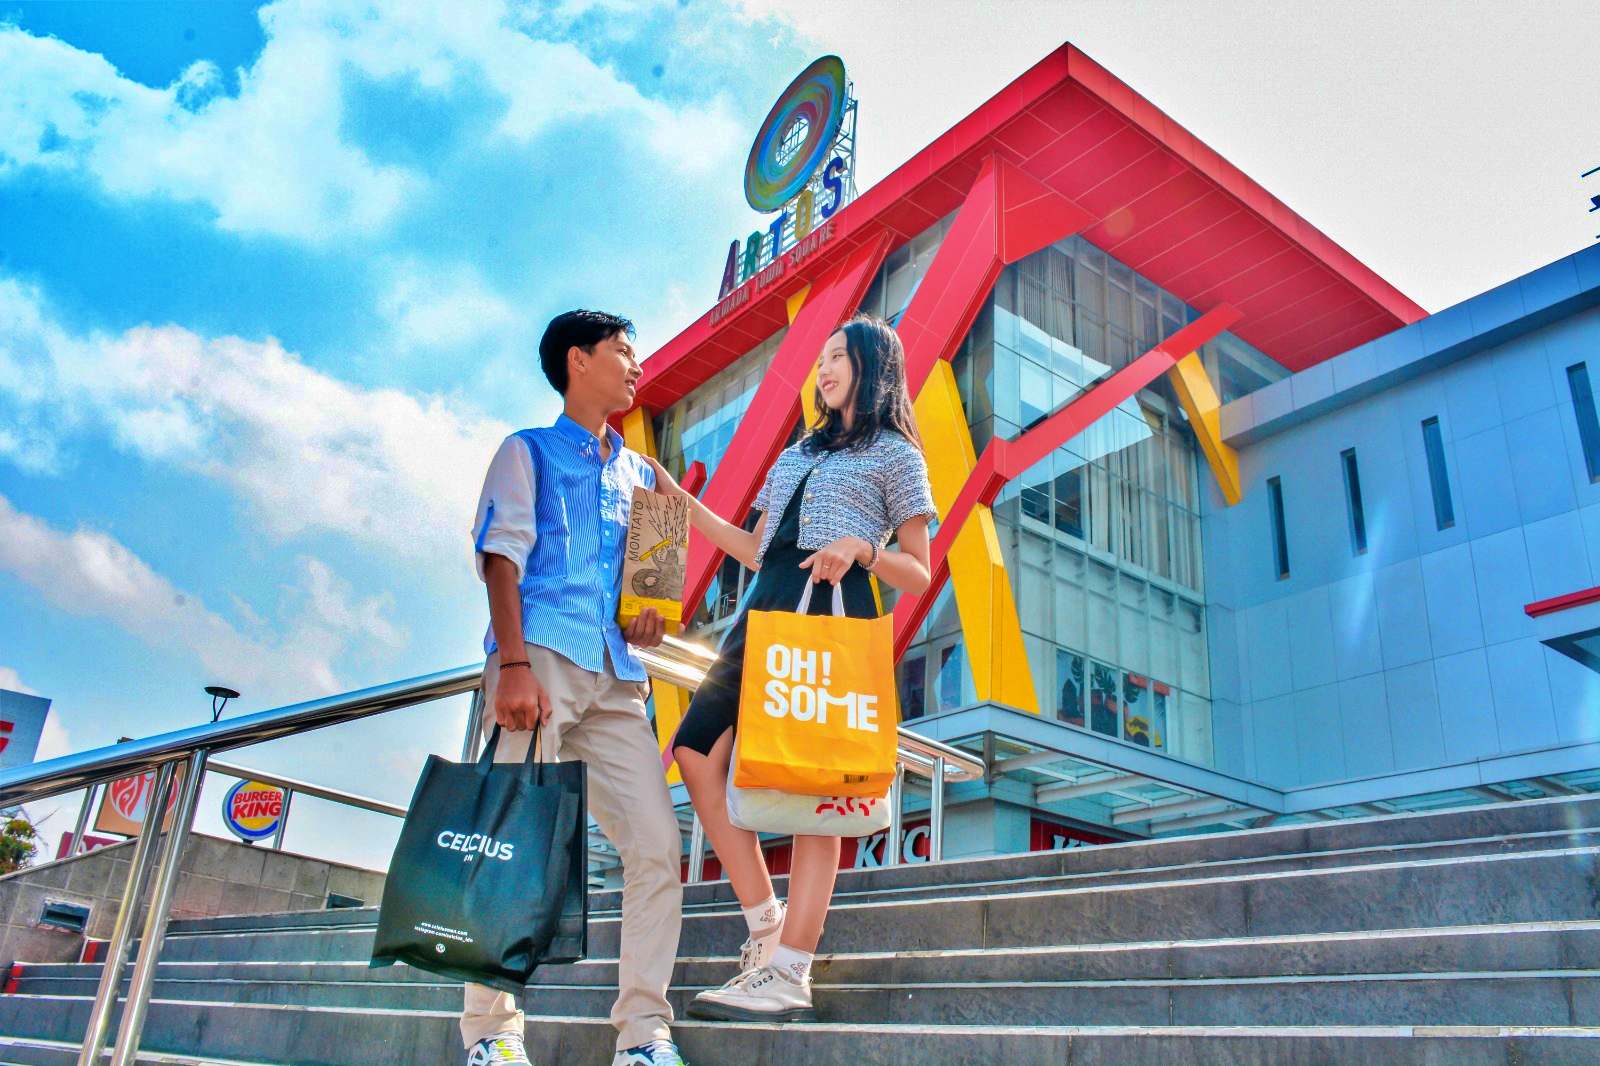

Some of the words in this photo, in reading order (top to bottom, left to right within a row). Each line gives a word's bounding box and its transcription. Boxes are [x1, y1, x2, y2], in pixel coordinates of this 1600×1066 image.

[718, 156, 846, 301] ARTOS
[628, 500, 645, 562] MONTATO
[765, 643, 832, 686] OH!
[763, 679, 879, 733] SOME
[232, 802, 282, 820] KING
[233, 791, 283, 804] BURGER
[437, 830, 514, 861] CELCIUS
